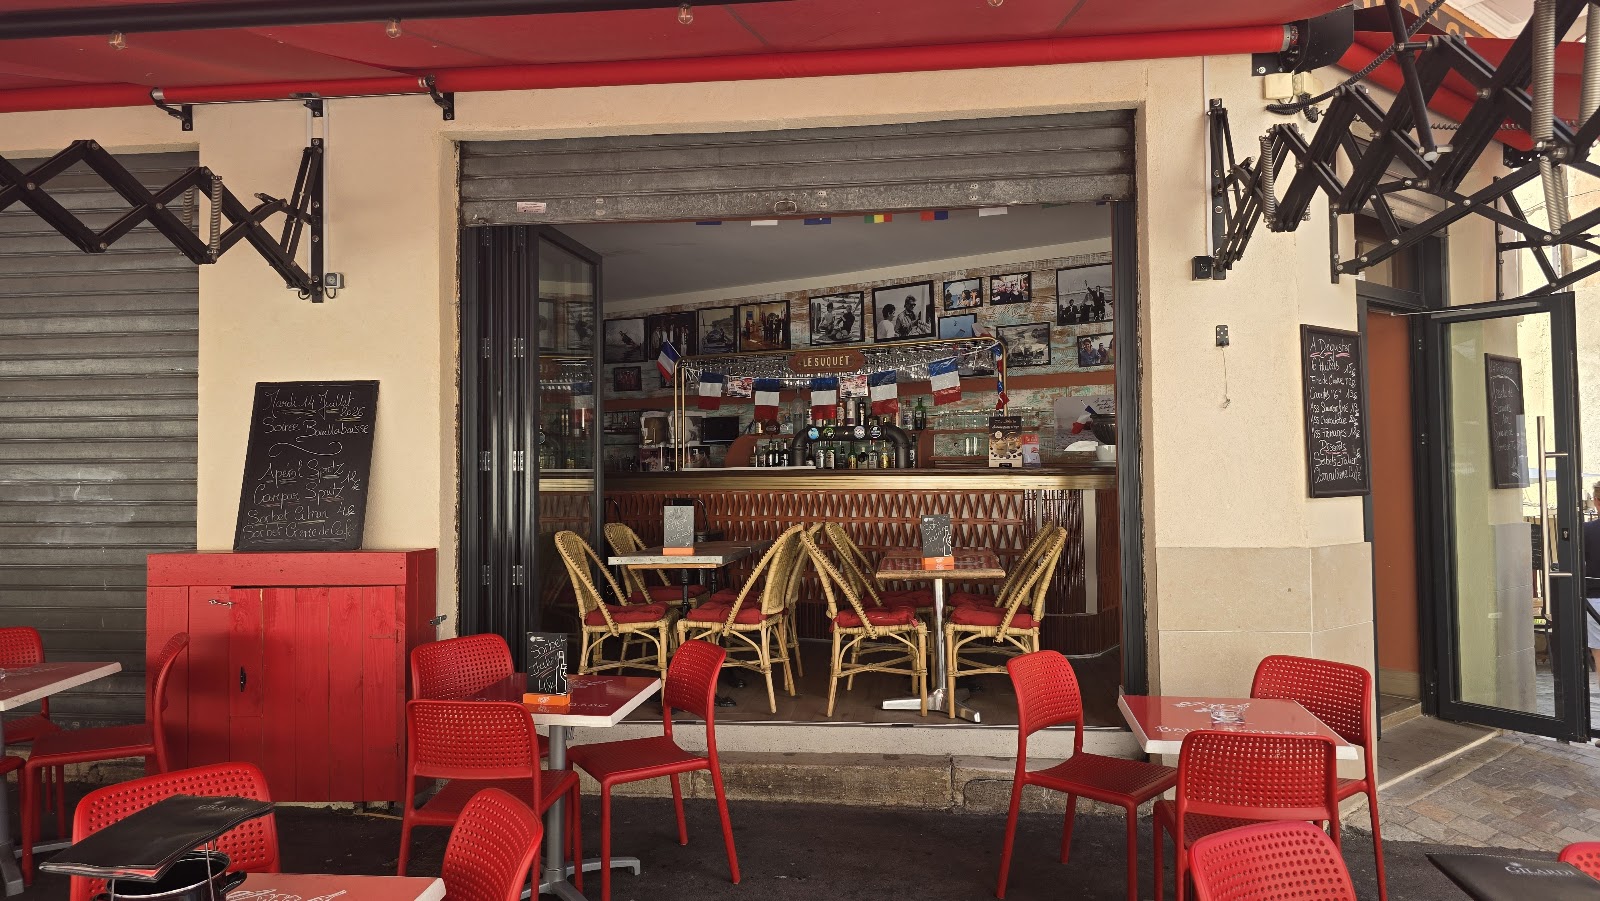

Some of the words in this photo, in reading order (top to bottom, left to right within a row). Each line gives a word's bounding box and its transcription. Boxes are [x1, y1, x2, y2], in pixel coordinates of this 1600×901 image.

[803, 357, 812, 368] LE
[814, 355, 850, 368] SUQUET
[262, 388, 298, 418] Mardi
[300, 395, 315, 410] 14
[318, 389, 355, 420] Juillet
[262, 416, 301, 434] Soirée
[307, 458, 346, 484] Spritz
[305, 481, 346, 506] Spritz
[247, 509, 290, 525] Sorbet
[294, 505, 329, 521] Citron
[242, 523, 283, 540] Sorbet
[530, 634, 567, 659] Sorbet
